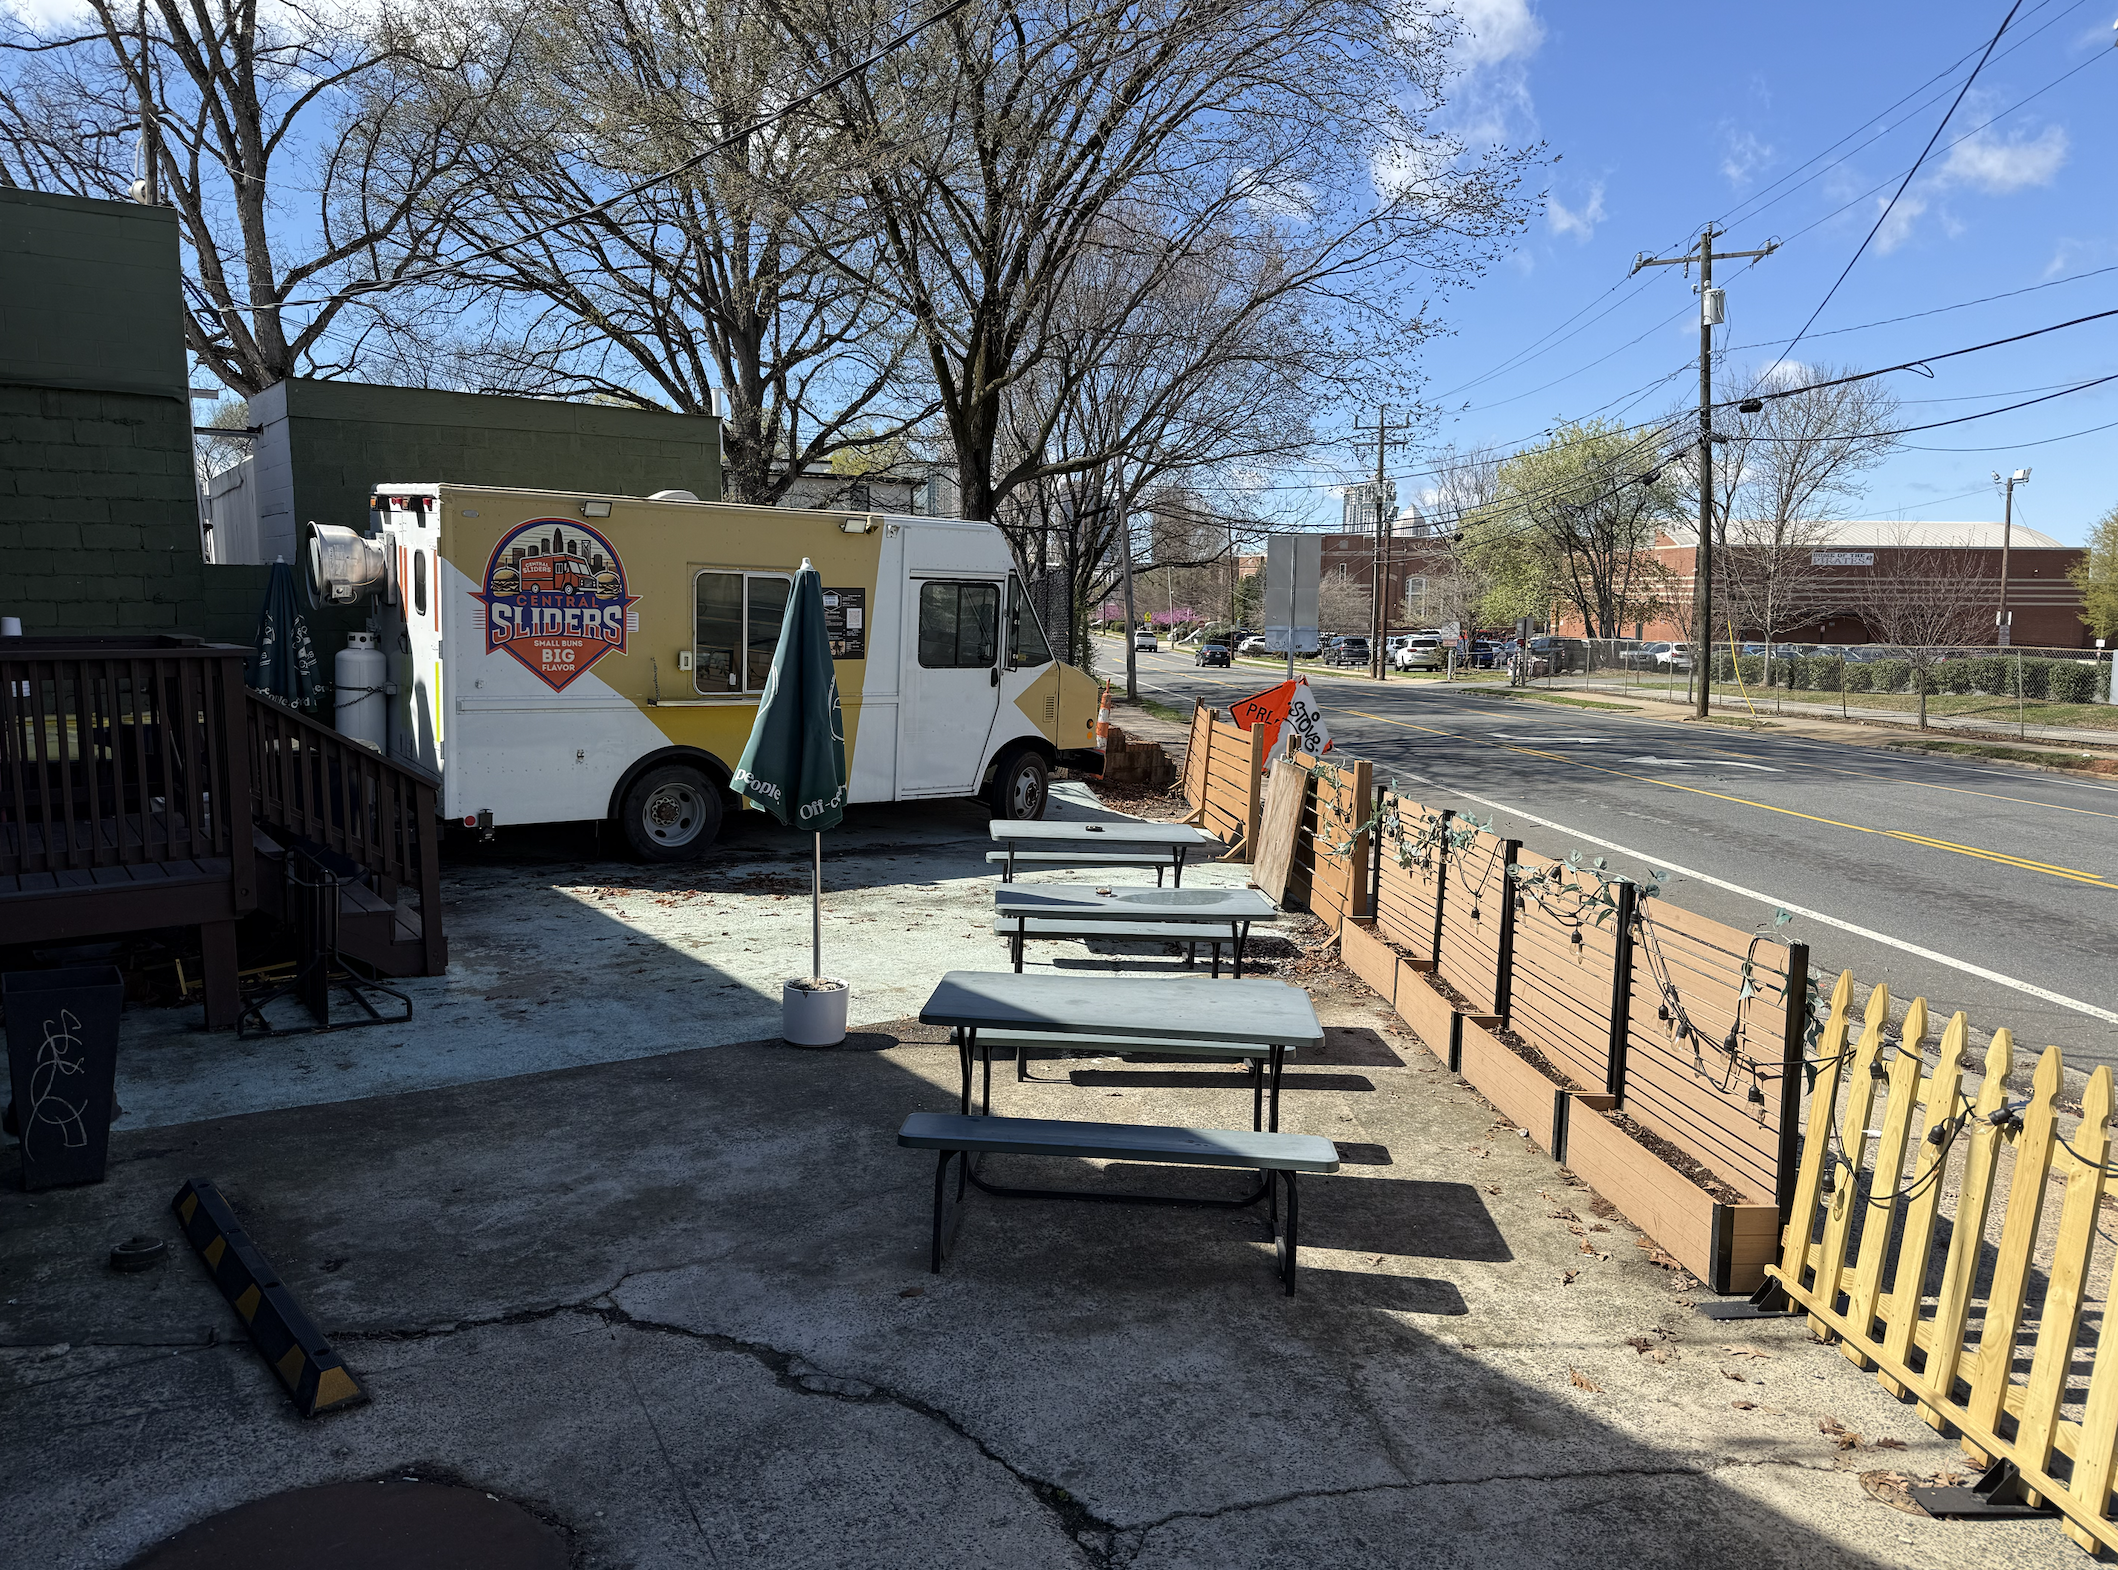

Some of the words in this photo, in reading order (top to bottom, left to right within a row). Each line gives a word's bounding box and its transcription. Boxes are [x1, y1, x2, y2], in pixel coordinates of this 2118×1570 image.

[522, 566, 552, 574] SLIDERS
[516, 594, 599, 608] CENTRAL
[491, 602, 623, 645] SLIDERS
[541, 649, 575, 663] BIG
[541, 664, 576, 672] FLAVOR
